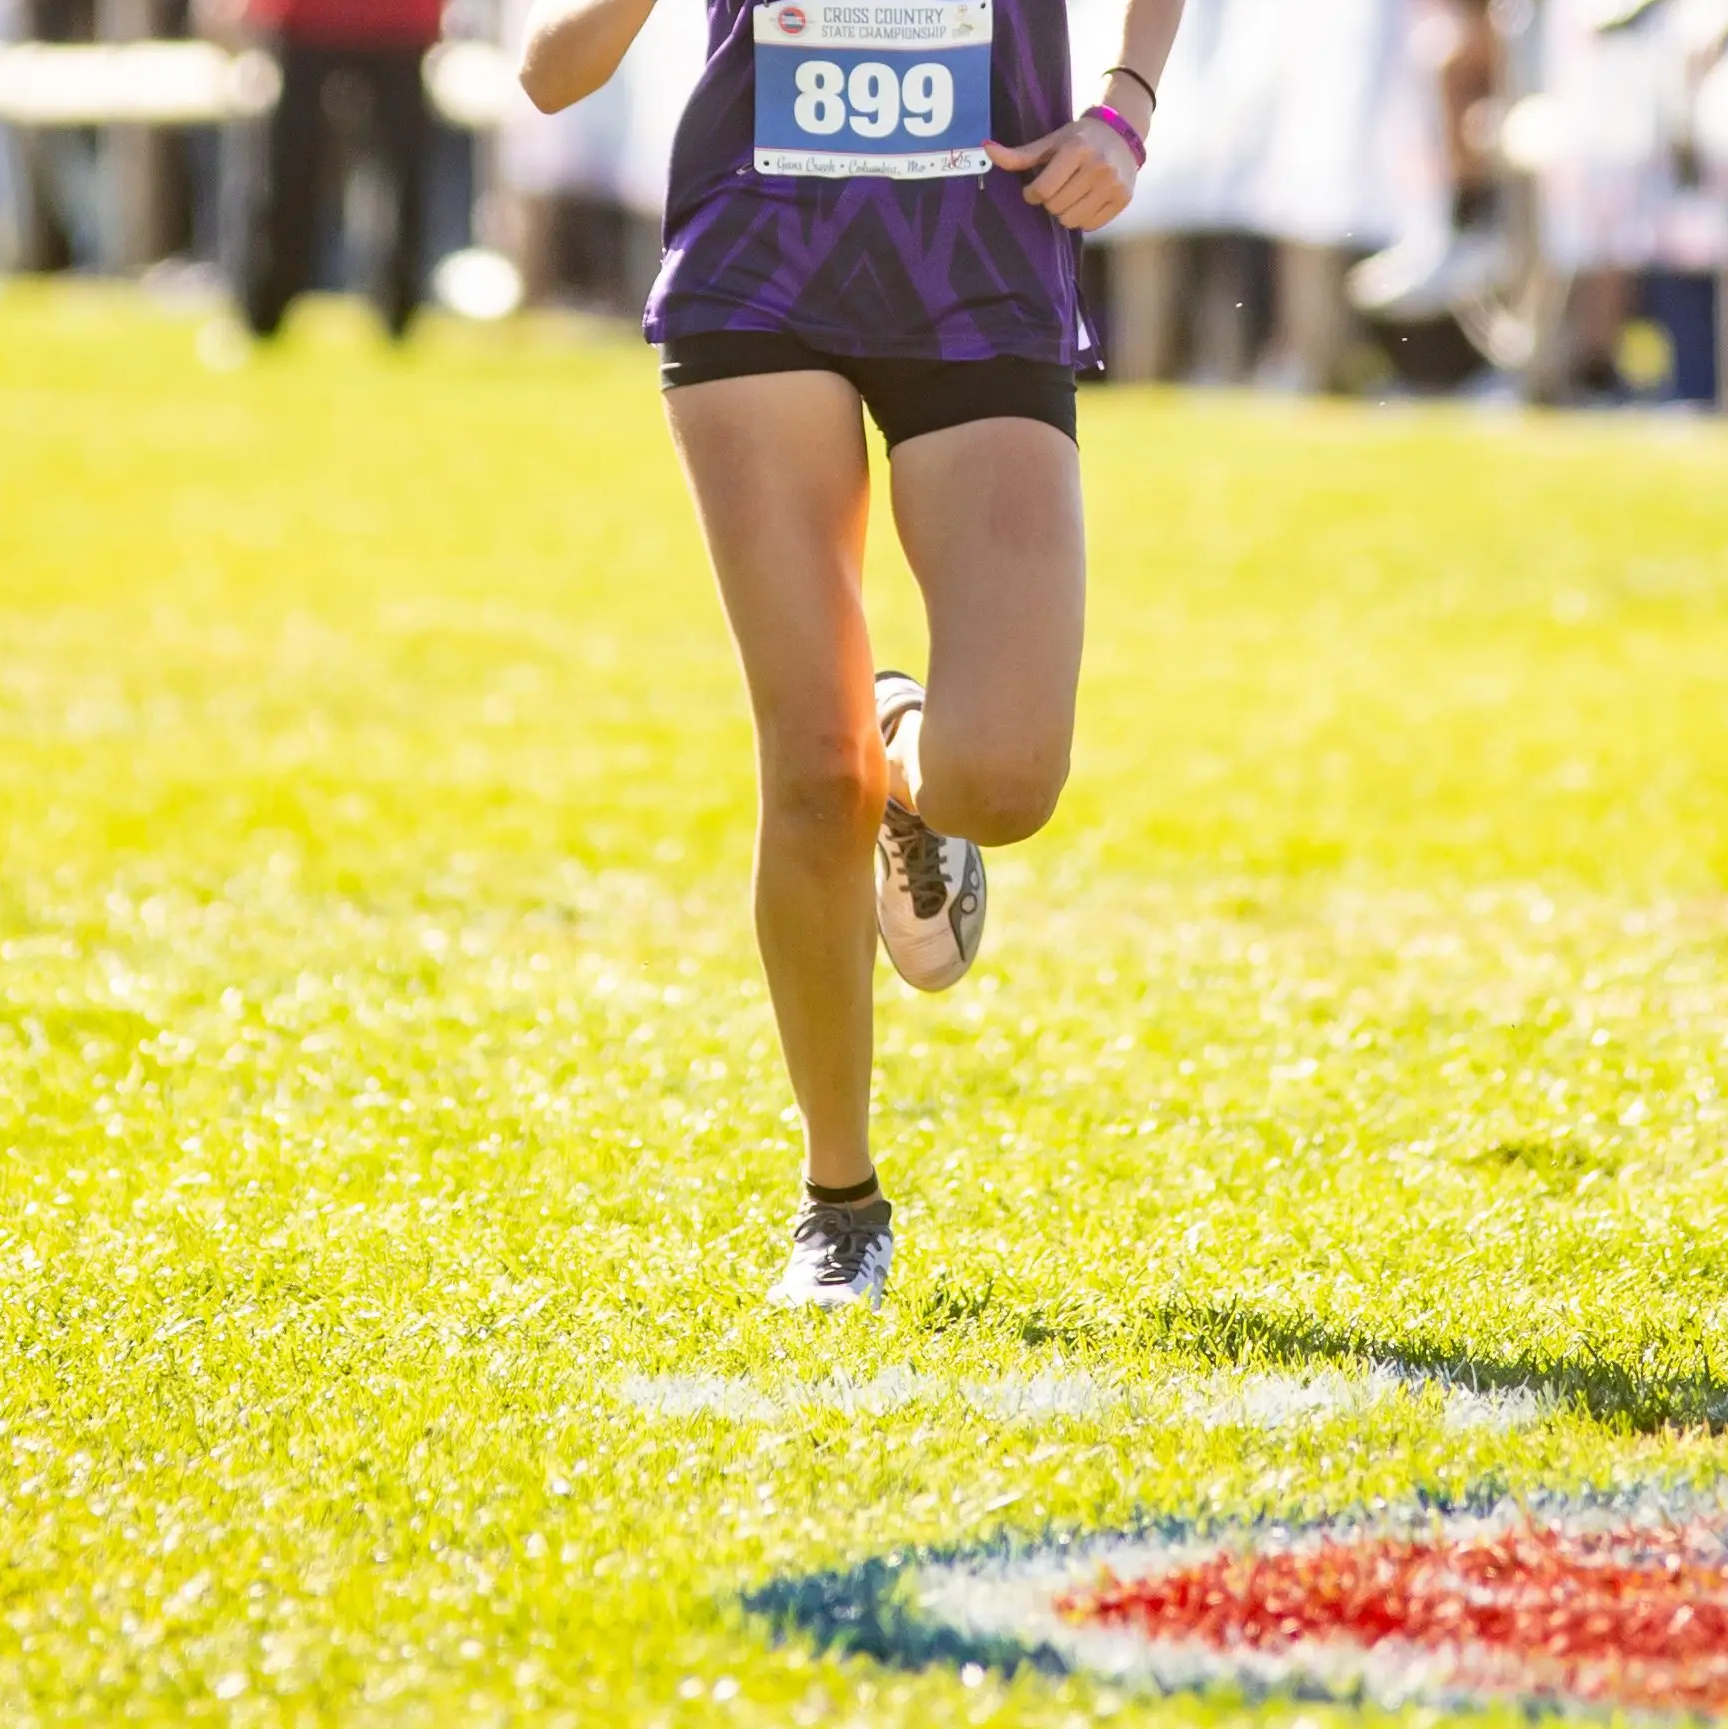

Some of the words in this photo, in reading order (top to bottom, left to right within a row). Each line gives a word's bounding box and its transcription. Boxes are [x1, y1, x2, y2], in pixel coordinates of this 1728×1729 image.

[823, 6, 869, 24] CROSS
[875, 7, 944, 25] COUNTRY
[821, 25, 855, 38] STATE
[859, 25, 947, 40] CHAMPIONSHIP
[794, 60, 954, 138] 899
[776, 155, 803, 170] Gans
[806, 156, 836, 172] Creek
